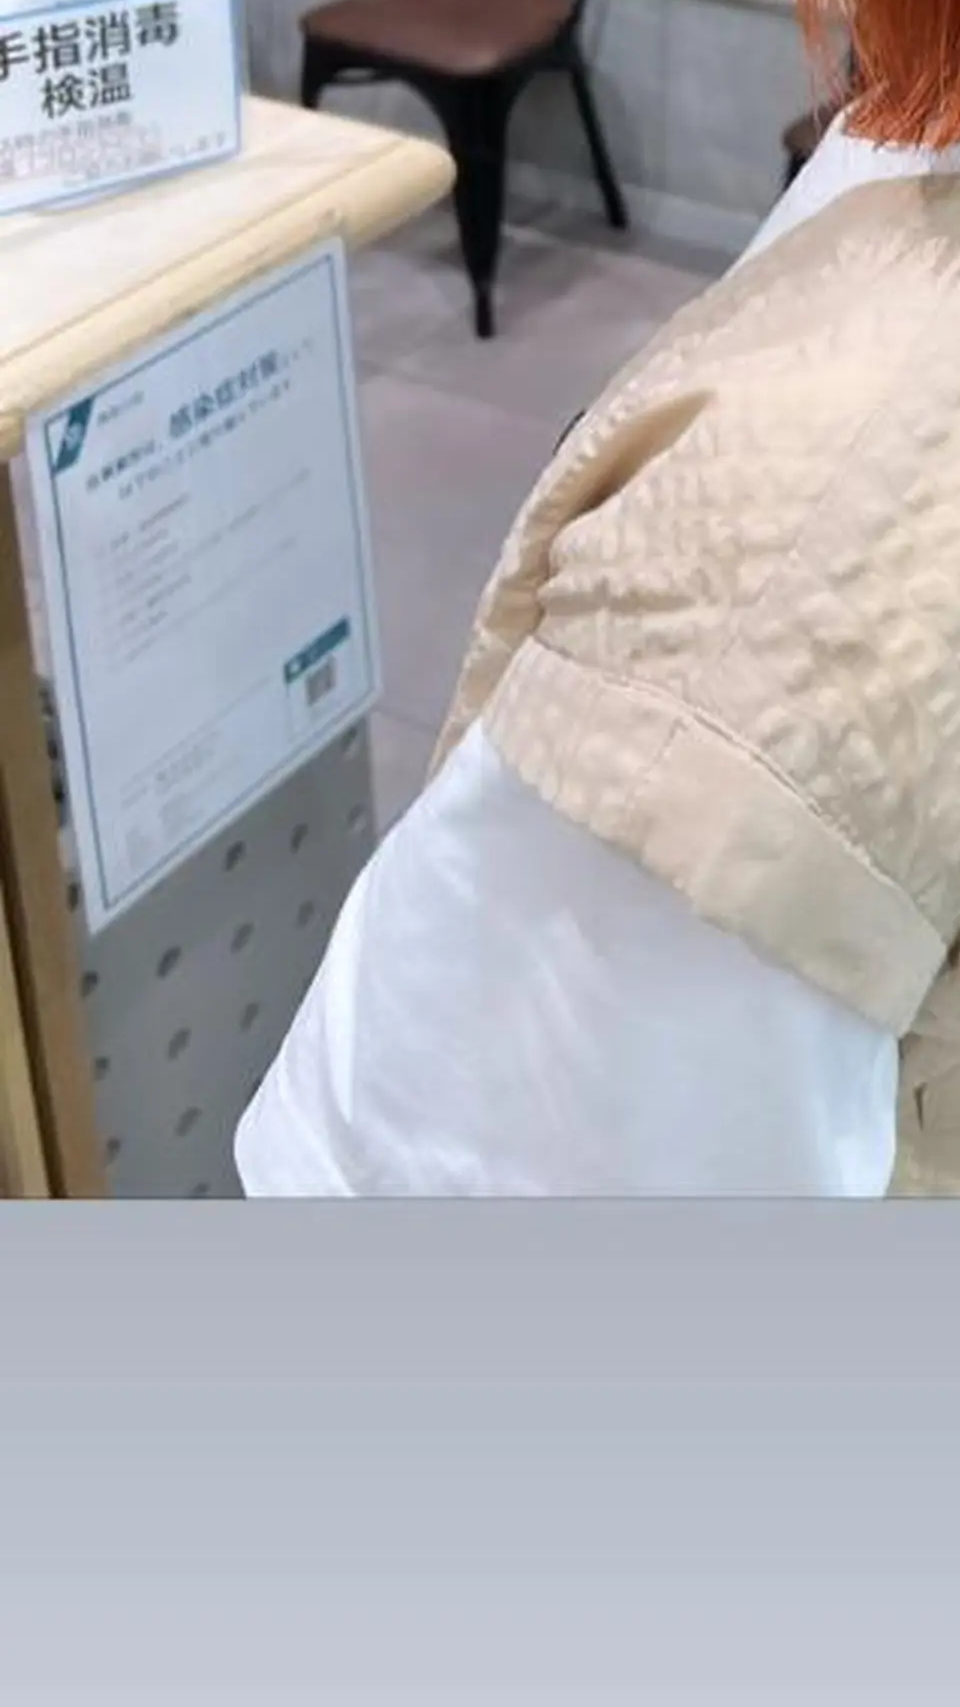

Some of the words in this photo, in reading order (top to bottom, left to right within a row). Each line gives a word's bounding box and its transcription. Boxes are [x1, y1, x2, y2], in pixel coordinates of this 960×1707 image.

[0, 0, 180, 81] 手指消毒
[41, 62, 132, 119] 検温
